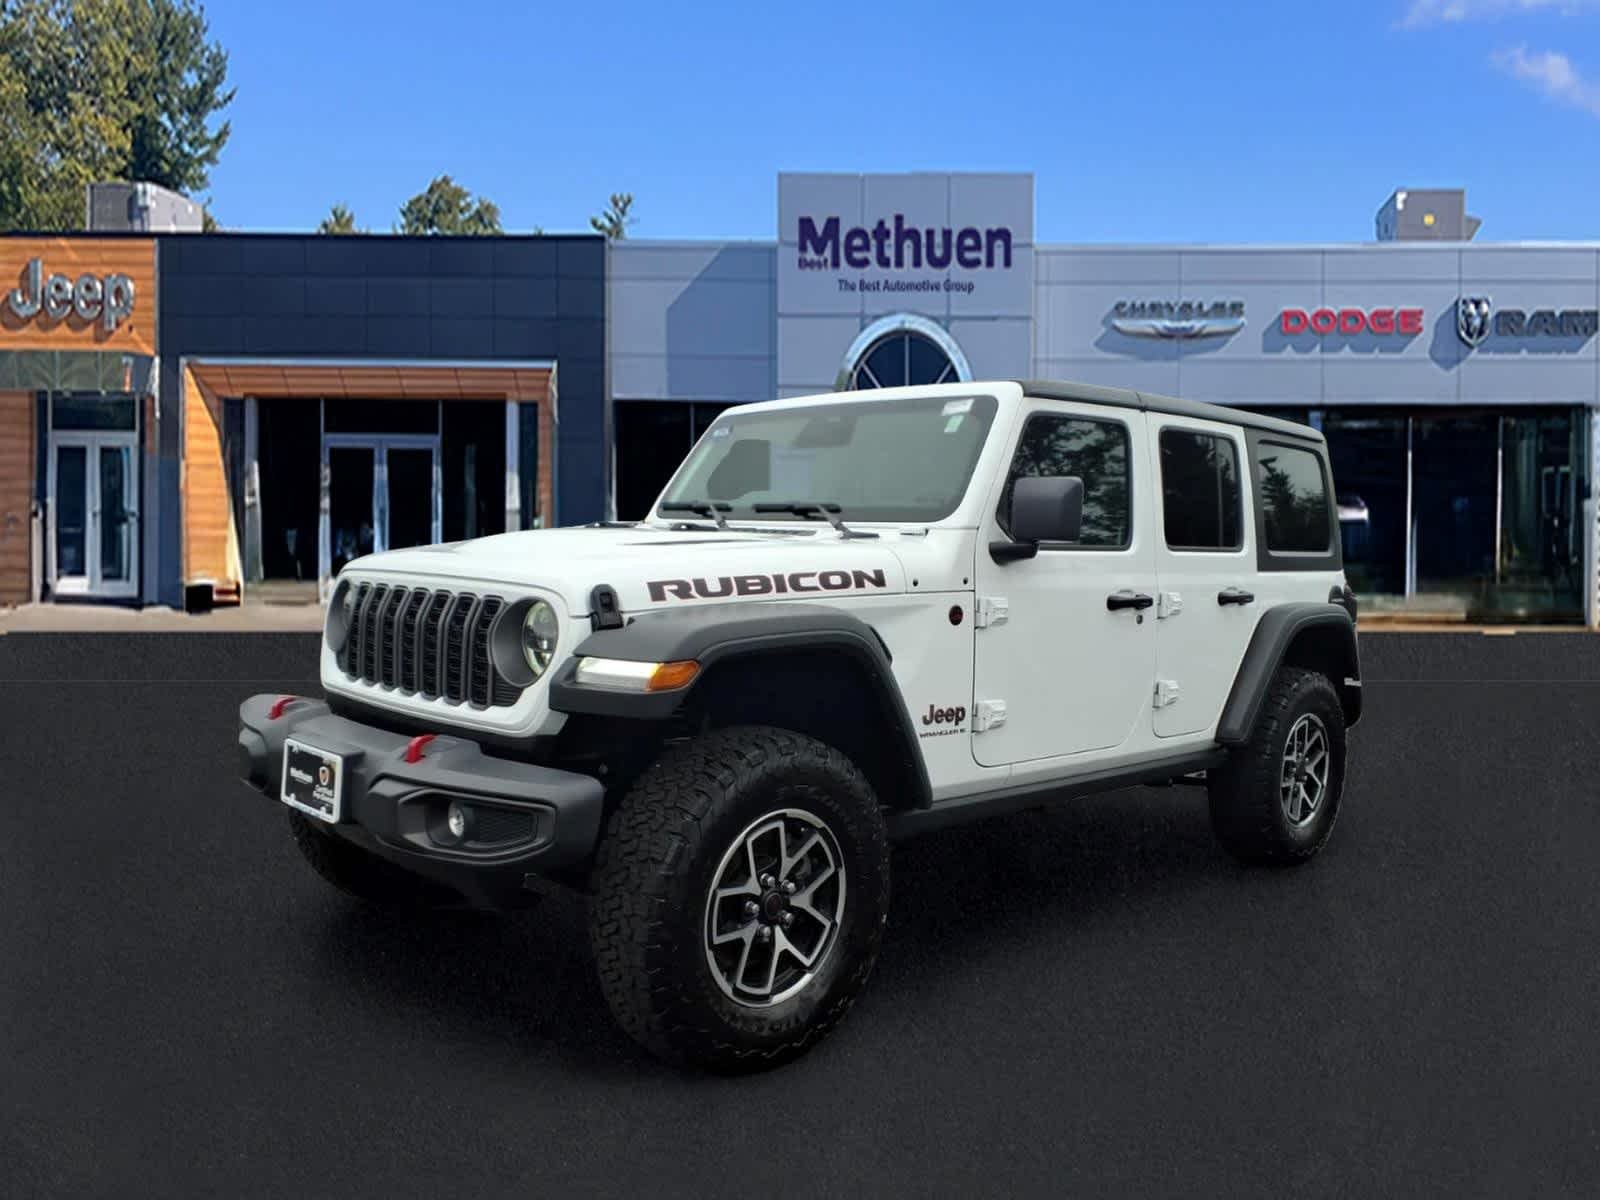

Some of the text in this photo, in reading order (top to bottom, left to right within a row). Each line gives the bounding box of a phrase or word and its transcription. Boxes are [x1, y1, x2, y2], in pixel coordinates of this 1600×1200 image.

[798, 214, 1012, 269] Methuen
[798, 256, 829, 270] Best
[8, 258, 135, 331] Jeep
[838, 279, 975, 294] The Best Automotive Group
[1282, 309, 1424, 334] DODGE
[1496, 310, 1599, 337] RAM
[647, 569, 886, 602] RUBICON
[922, 704, 966, 726] Jeep
